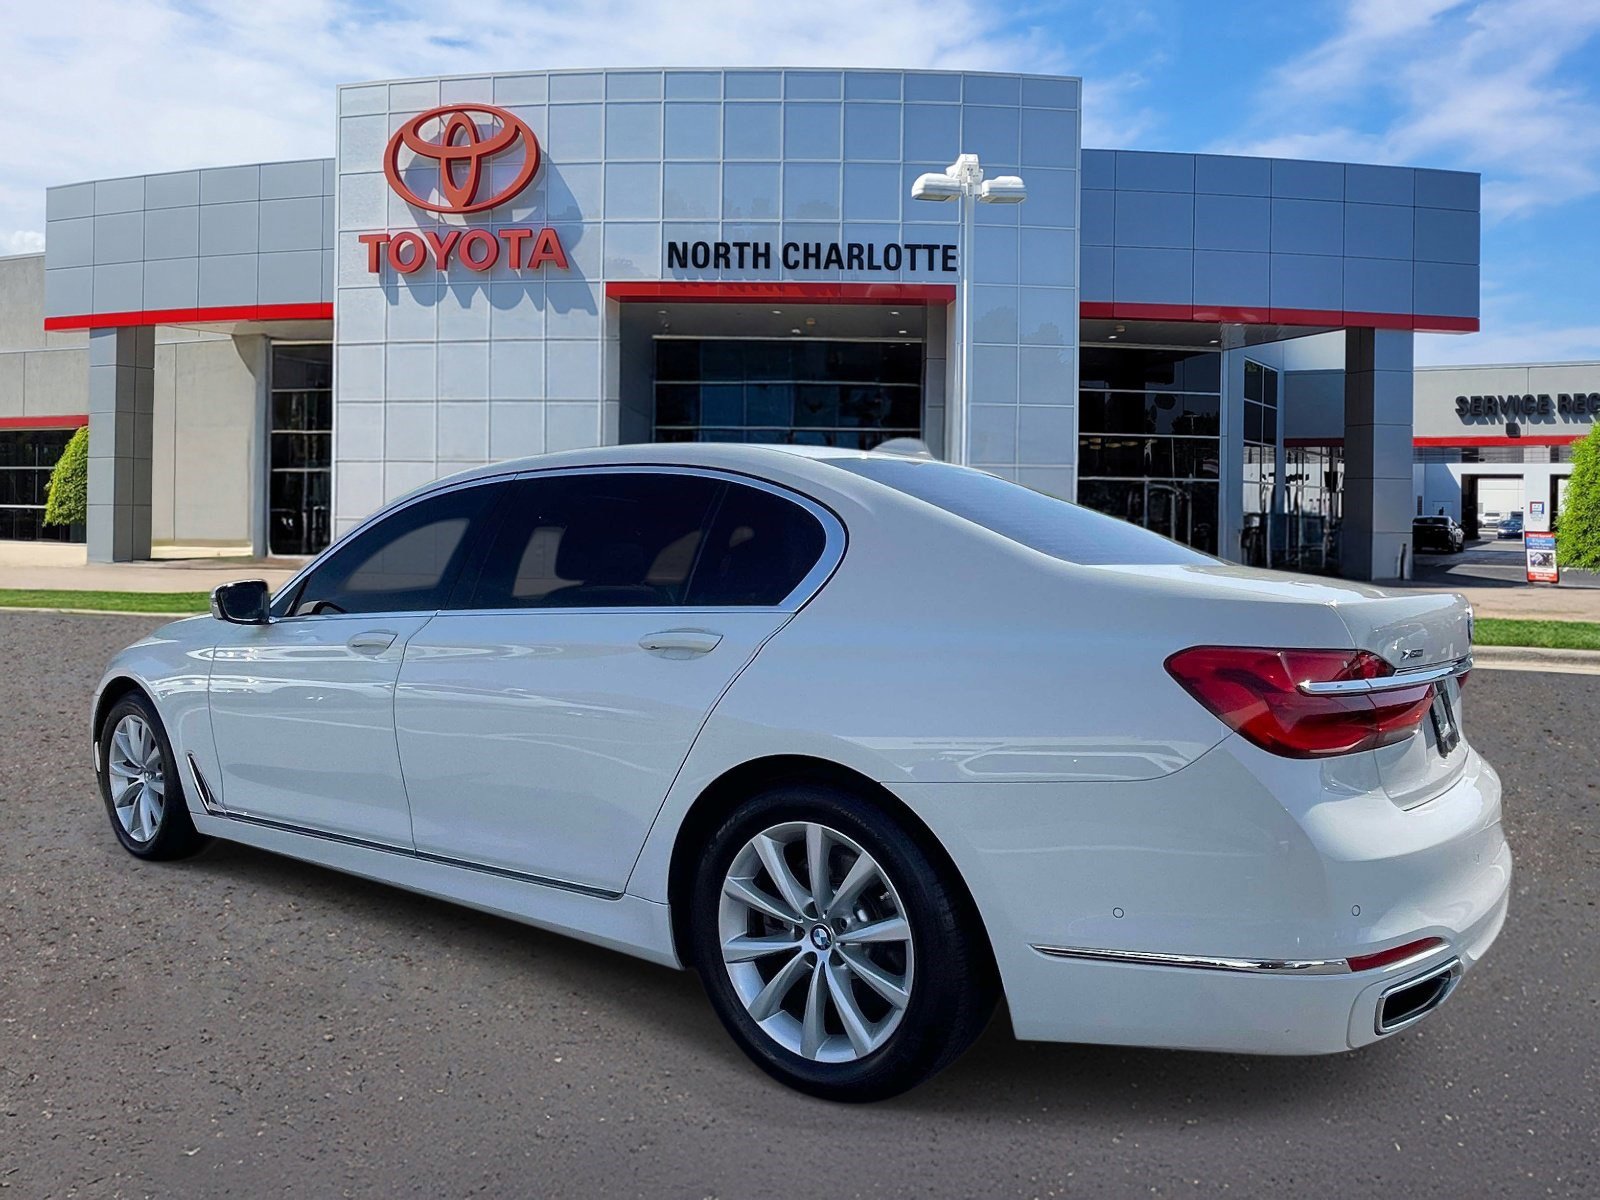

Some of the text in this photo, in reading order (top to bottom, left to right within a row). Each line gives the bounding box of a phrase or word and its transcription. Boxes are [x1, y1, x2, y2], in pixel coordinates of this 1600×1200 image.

[358, 228, 569, 273] TOYOTA
[667, 241, 957, 272] NORTH CHARLOTTE
[1455, 394, 1551, 417] SERVICE
